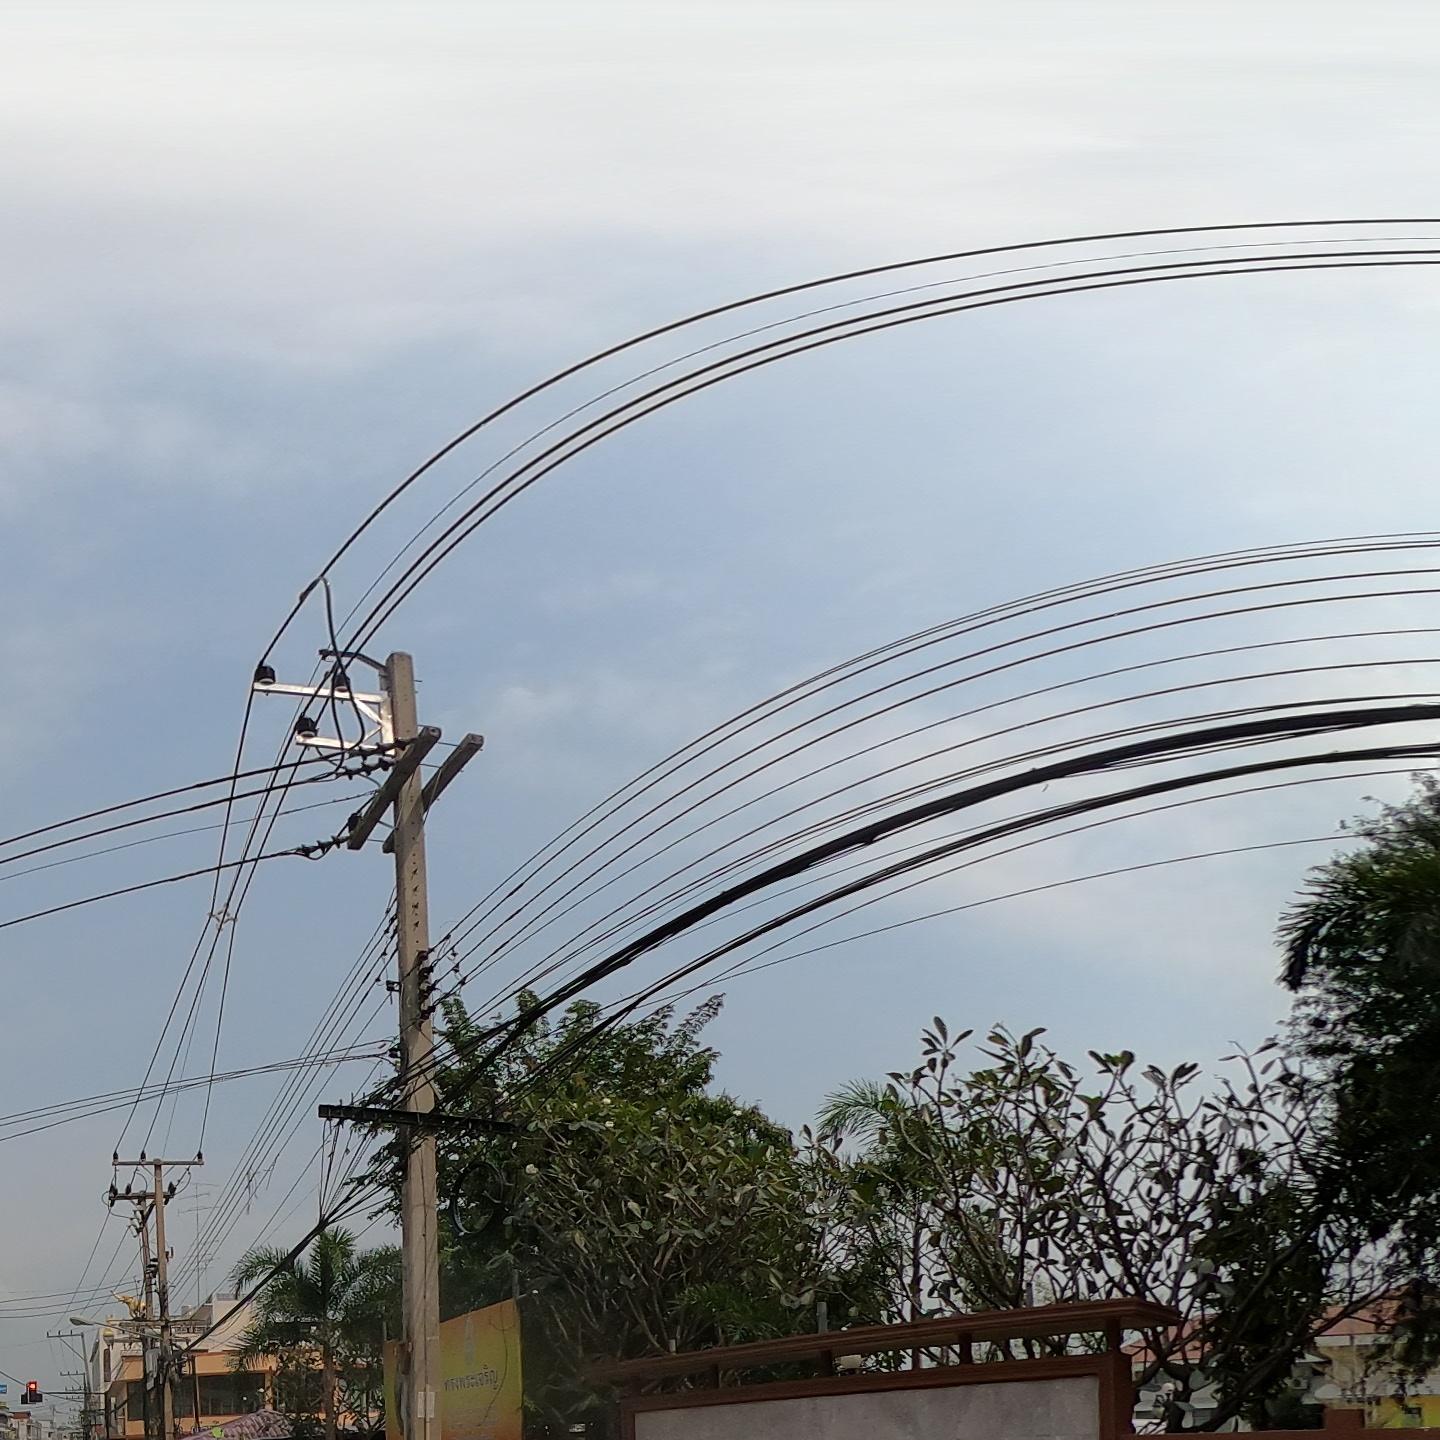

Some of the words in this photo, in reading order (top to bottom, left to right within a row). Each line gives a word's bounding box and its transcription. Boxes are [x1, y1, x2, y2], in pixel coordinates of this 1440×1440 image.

[445, 1364, 498, 1391] ทรงพระเจริญ
